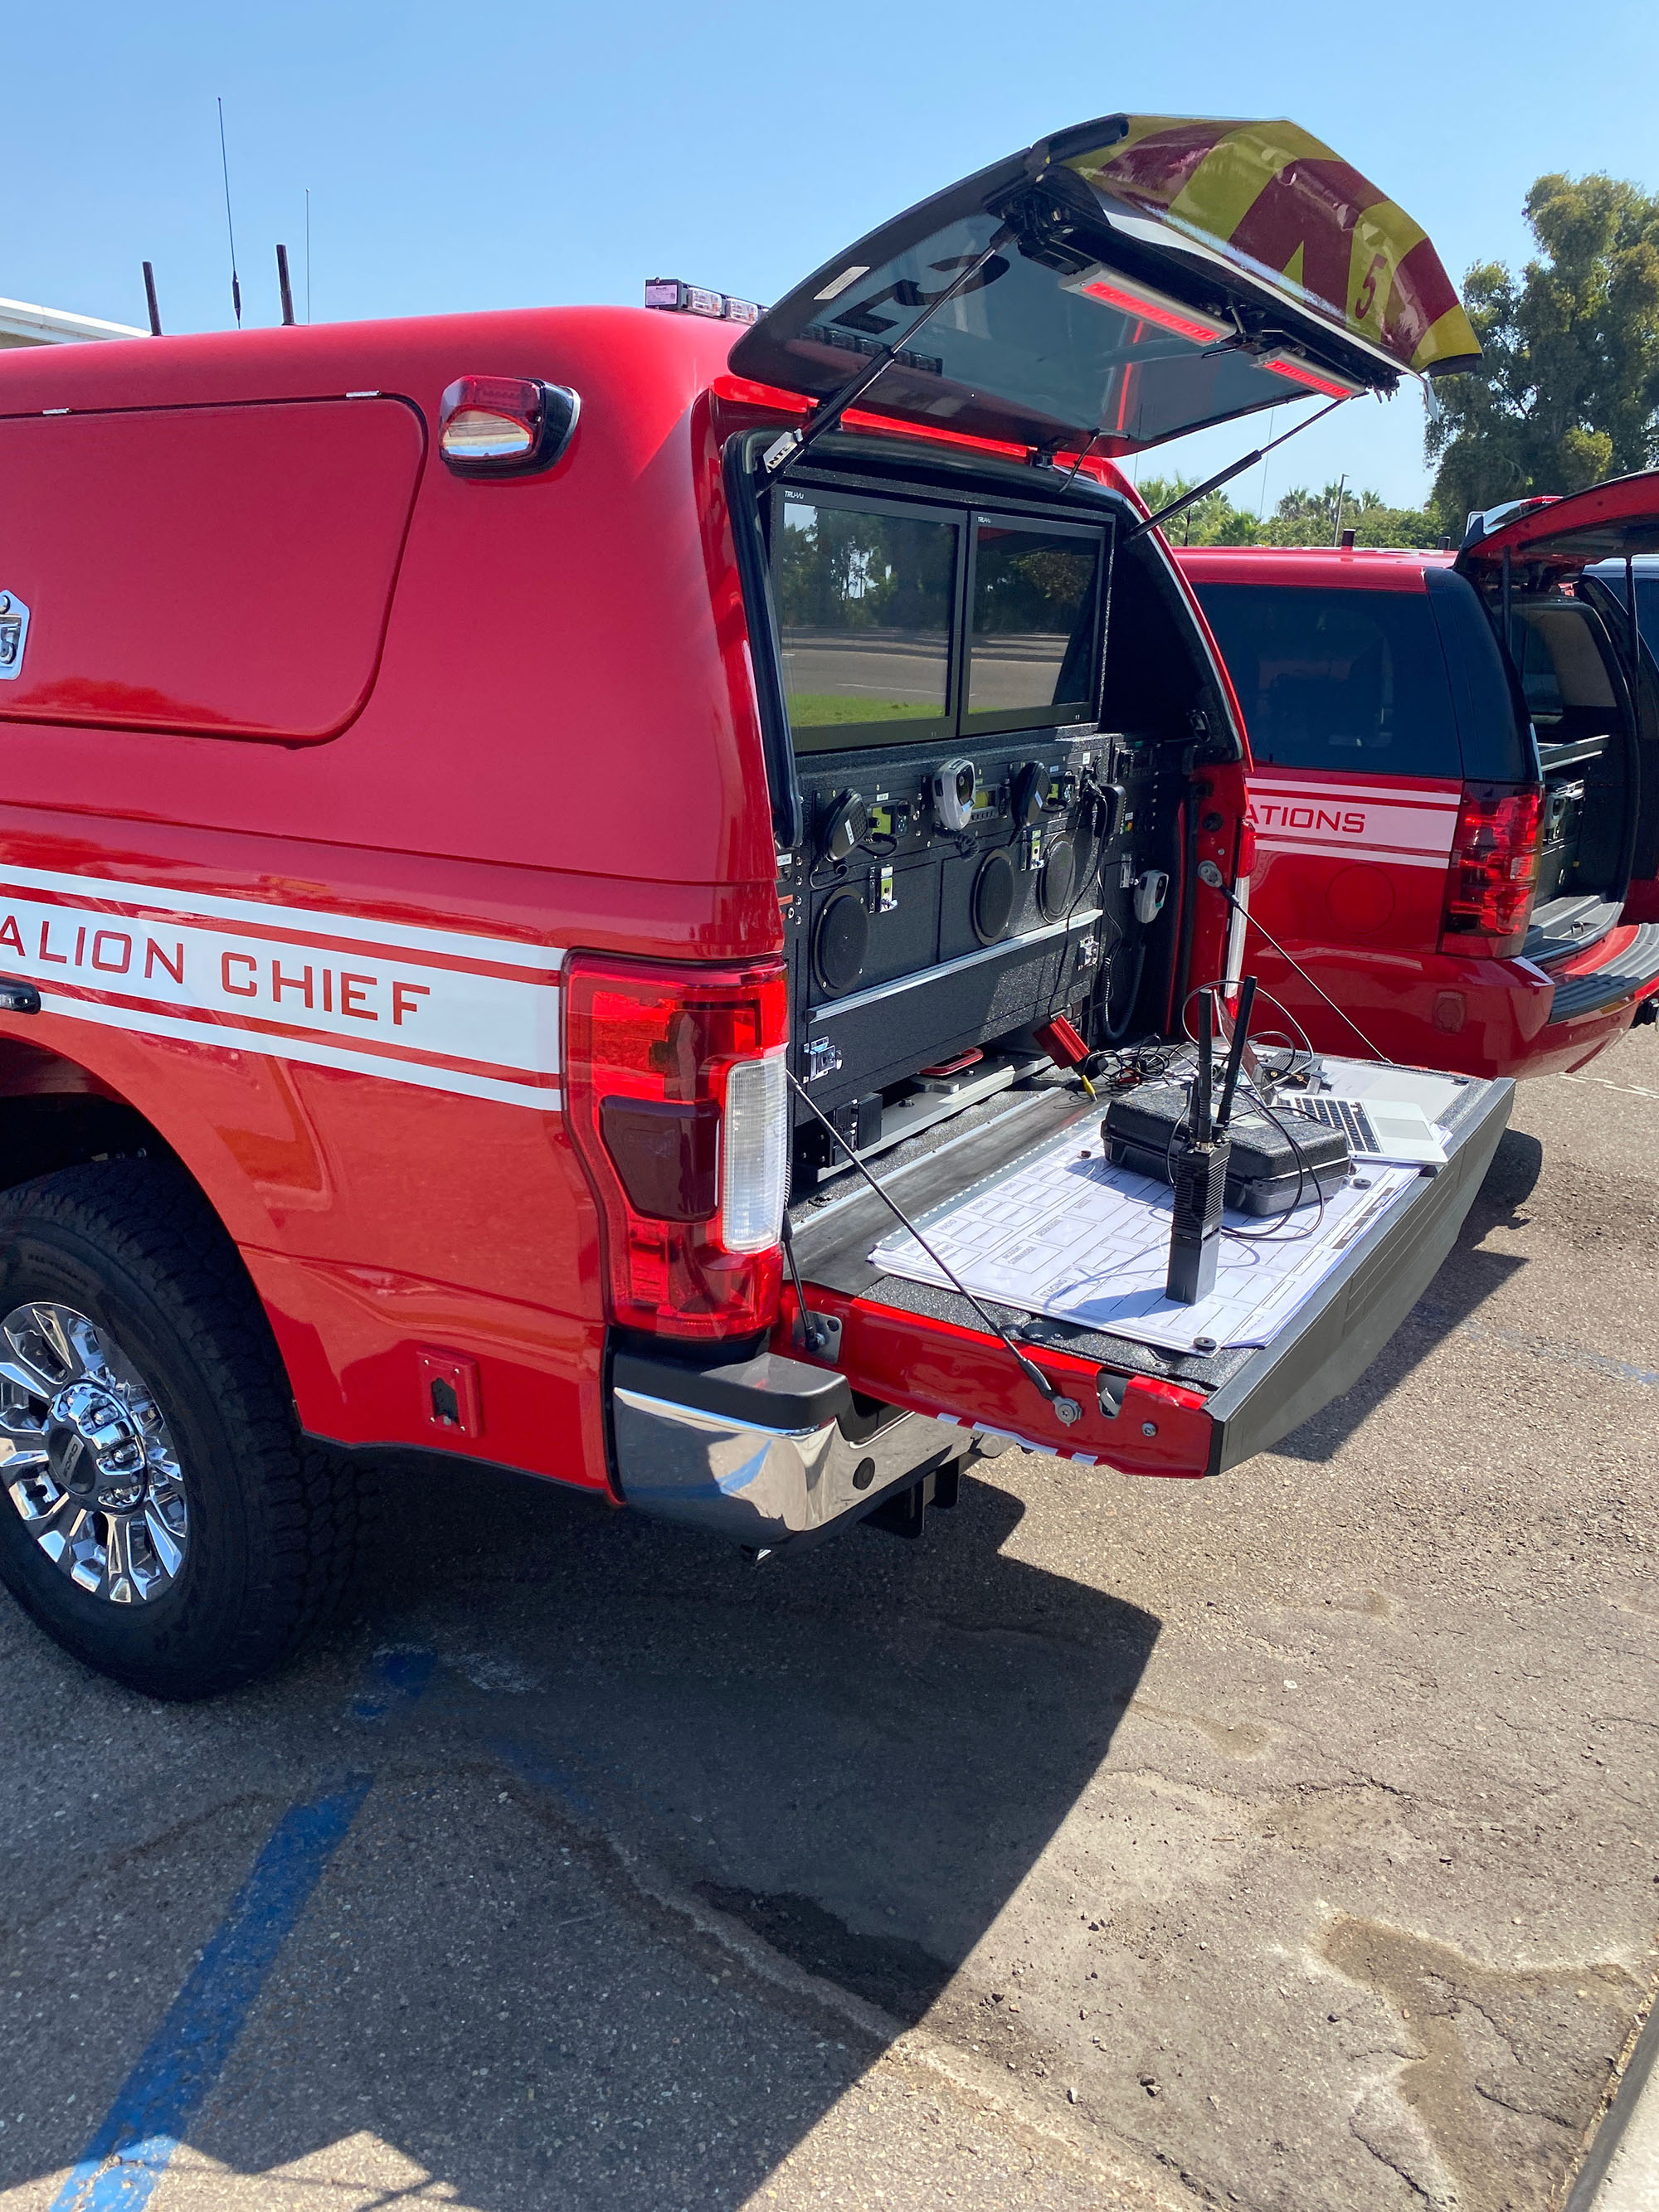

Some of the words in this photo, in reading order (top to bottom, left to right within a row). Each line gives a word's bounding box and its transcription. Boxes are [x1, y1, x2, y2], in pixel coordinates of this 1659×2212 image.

[1355, 253, 1388, 319] 5
[0, 915, 184, 984] ALION
[221, 951, 431, 1025] CHIEF
